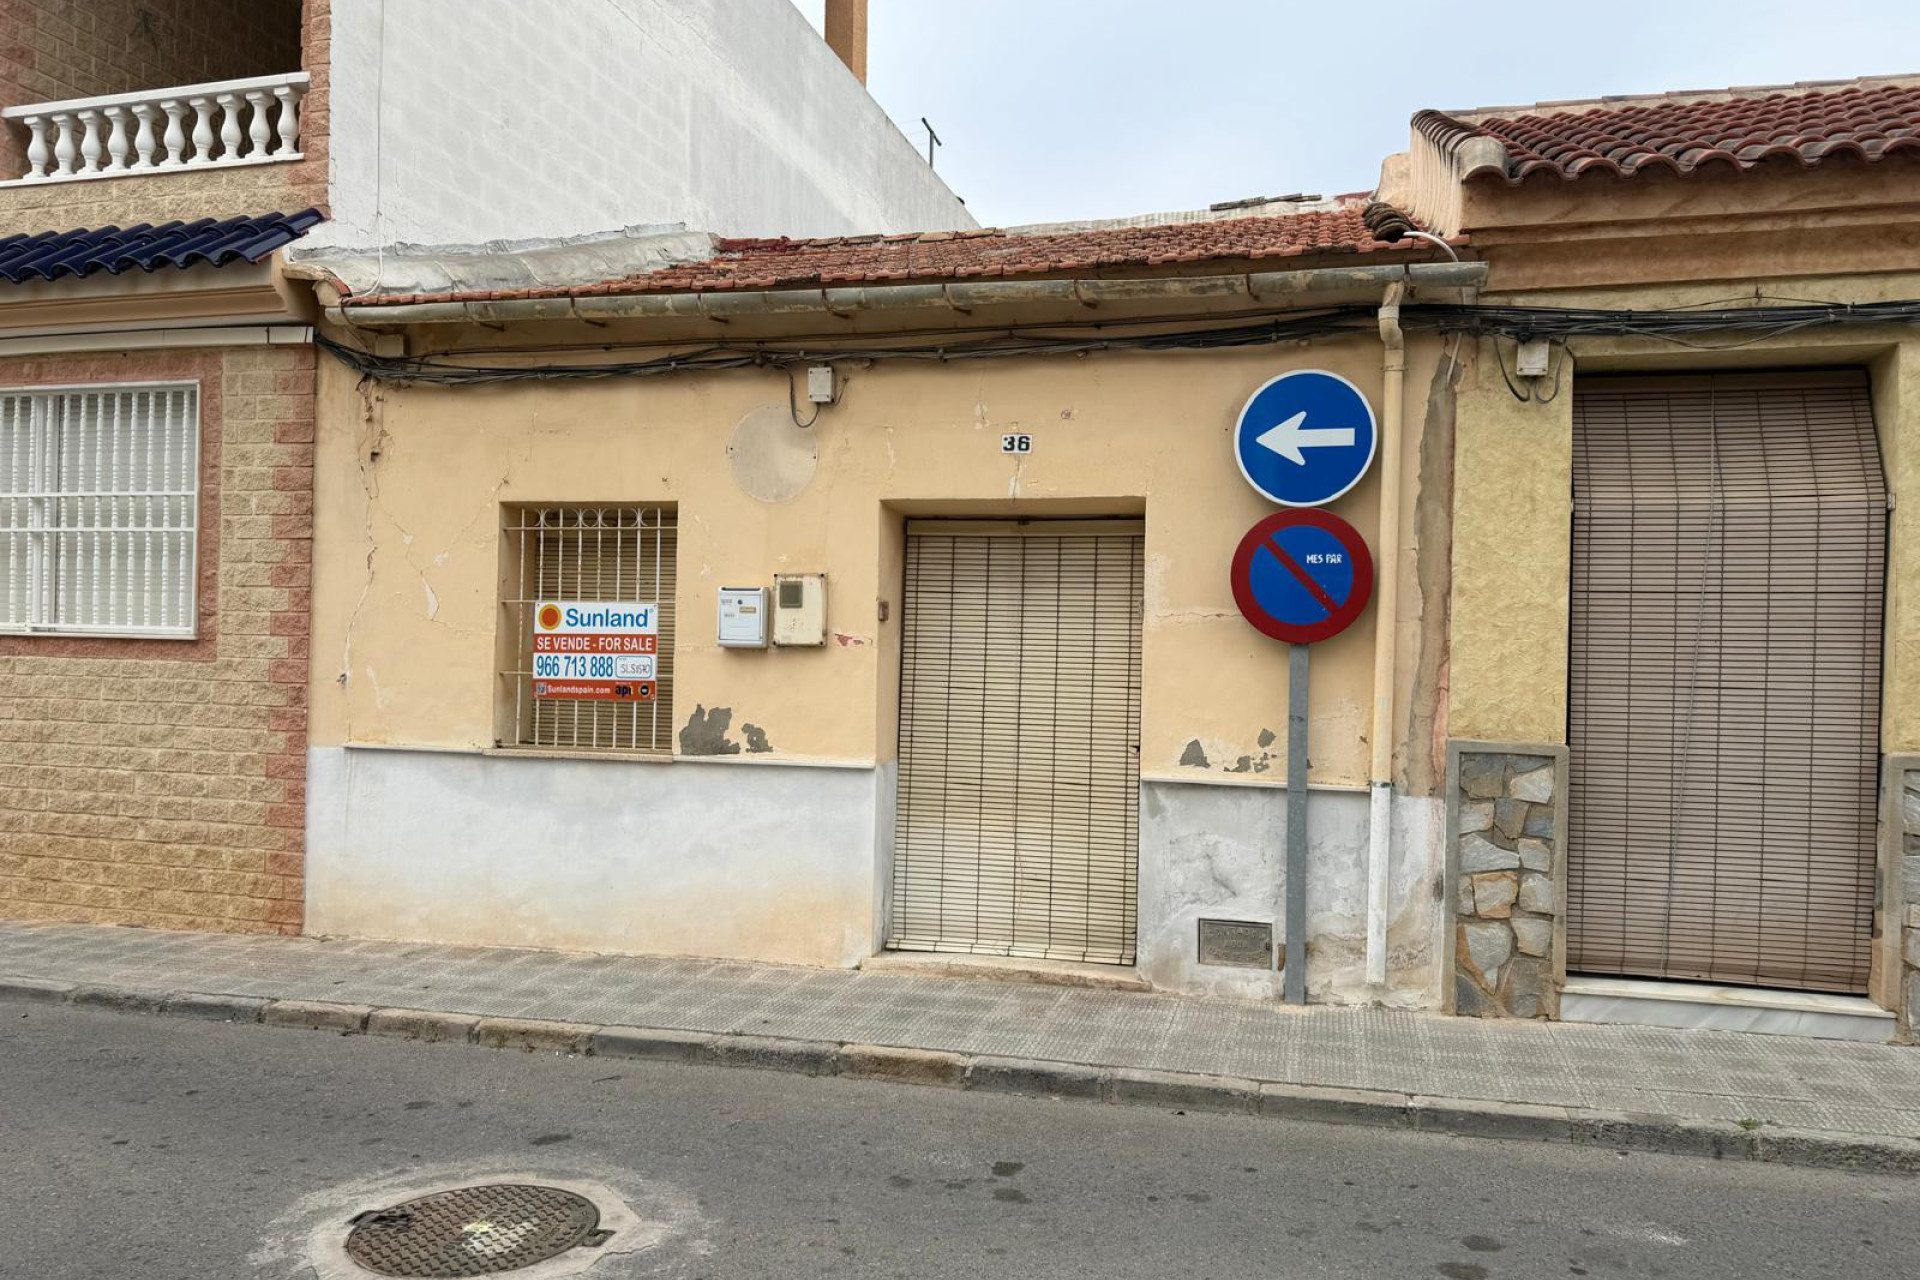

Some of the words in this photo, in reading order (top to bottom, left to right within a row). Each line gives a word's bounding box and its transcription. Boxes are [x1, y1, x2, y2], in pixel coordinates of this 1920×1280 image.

[1002, 435, 1031, 452] 36
[1306, 554, 1324, 564] MES
[1325, 553, 1343, 564] PAR
[565, 608, 649, 628] Sunland
[537, 637, 551, 651] SE
[553, 637, 591, 651] VENDE
[598, 638, 621, 651] FOR
[623, 638, 653, 651] SALE
[536, 655, 560, 677] 966
[564, 656, 587, 677] 713
[590, 656, 614, 677] 888
